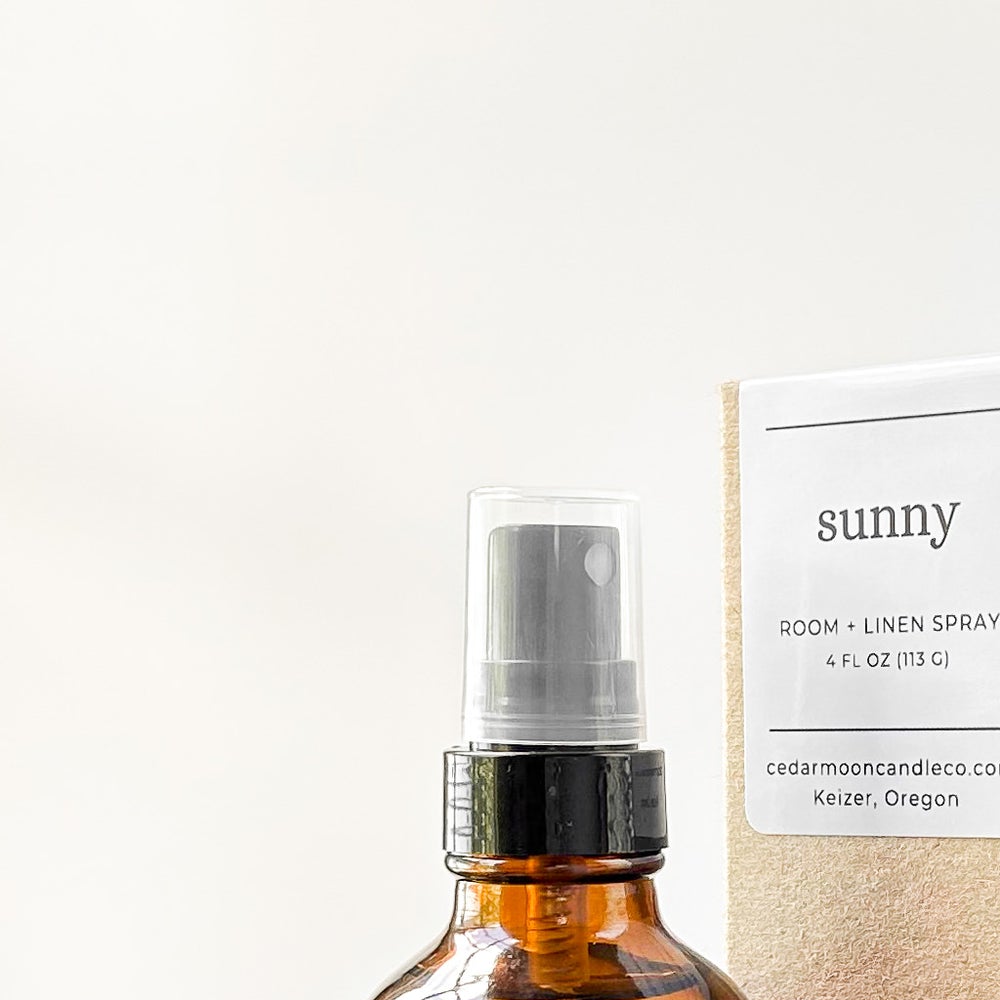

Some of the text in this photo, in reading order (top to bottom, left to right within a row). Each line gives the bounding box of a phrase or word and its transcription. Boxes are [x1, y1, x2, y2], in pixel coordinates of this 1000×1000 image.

[817, 502, 962, 549] sunny
[780, 612, 1000, 637] ROOM + LINEN SPRAY
[826, 649, 949, 671] 4 FL OZ (113 G)
[813, 788, 959, 812] Keizer, Oregon
